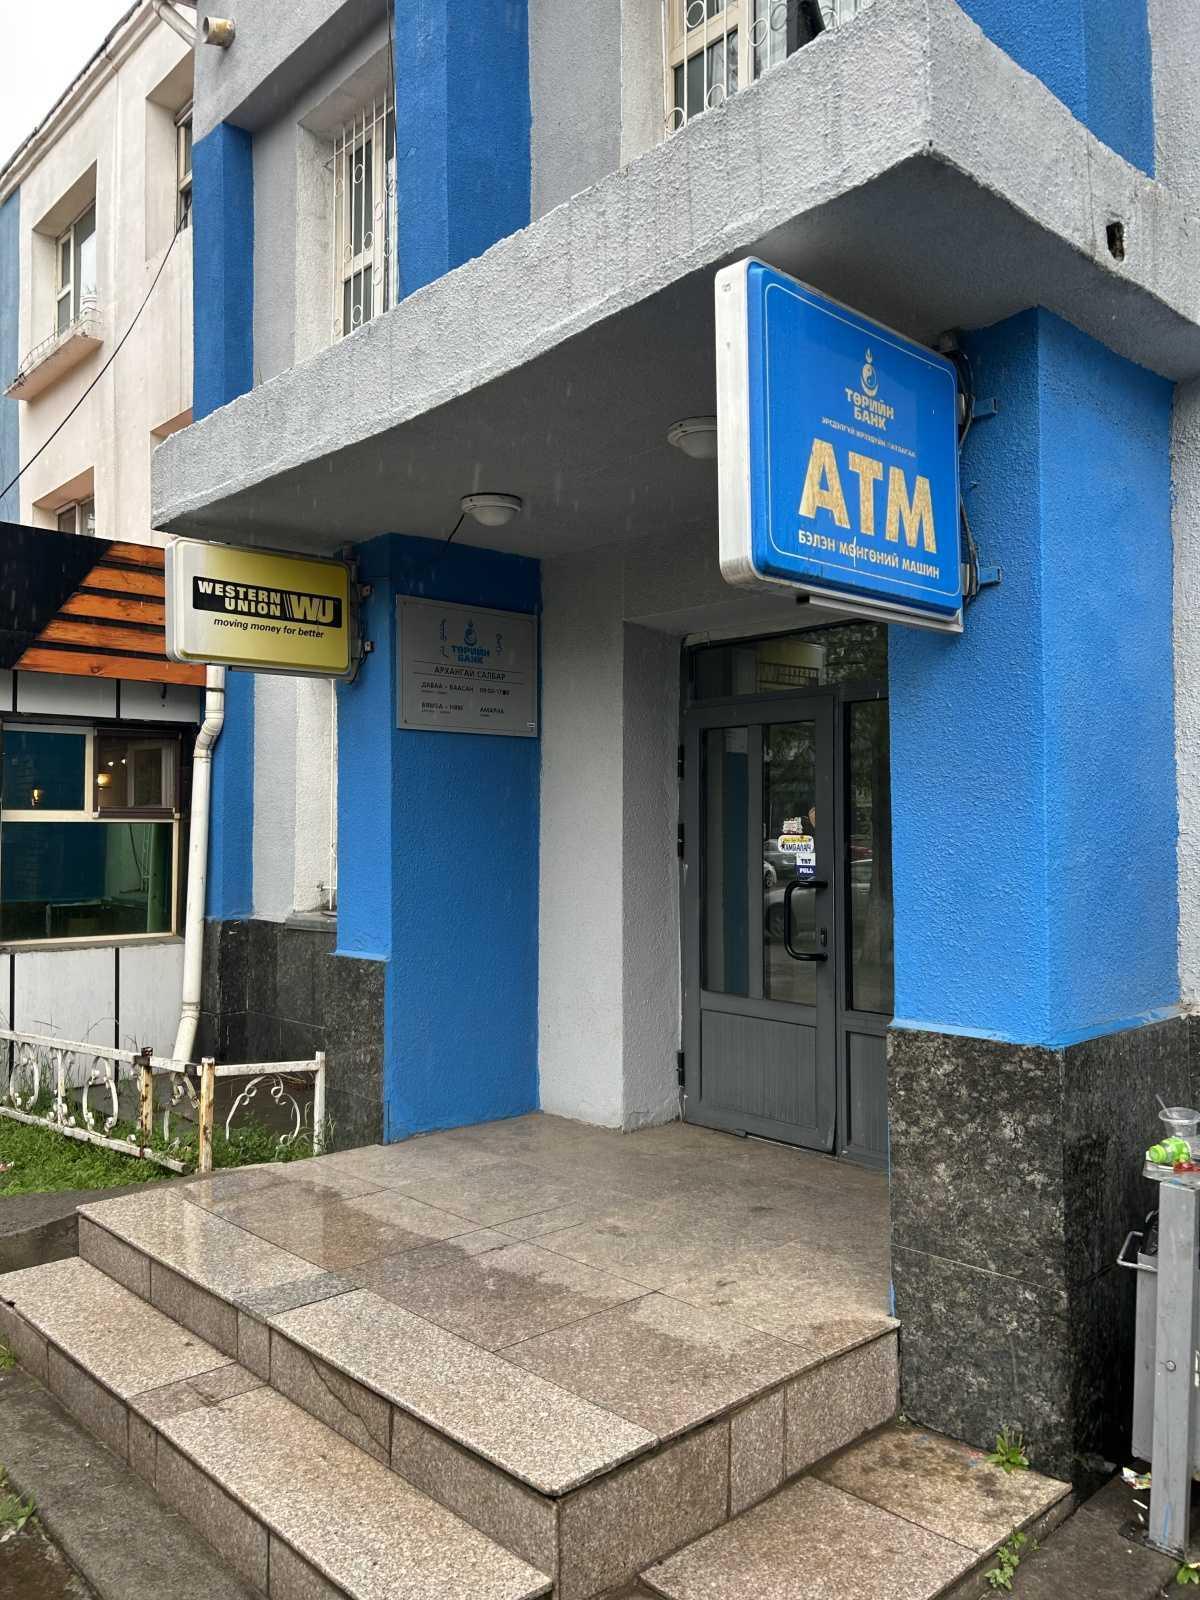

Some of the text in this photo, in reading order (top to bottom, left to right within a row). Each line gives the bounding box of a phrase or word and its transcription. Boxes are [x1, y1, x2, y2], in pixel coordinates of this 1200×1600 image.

[845, 387, 895, 421] ТӨРИЙН
[853, 408, 887, 431] БАНК
[799, 438, 936, 554] АТМ
[798, 529, 939, 579] БЭЛЭН МӨНГӨНИЙ МАШИН
[197, 580, 281, 604] WESTERN
[224, 598, 281, 616] UNION
[290, 595, 334, 624] WU
[213, 618, 325, 638] moving money for better
